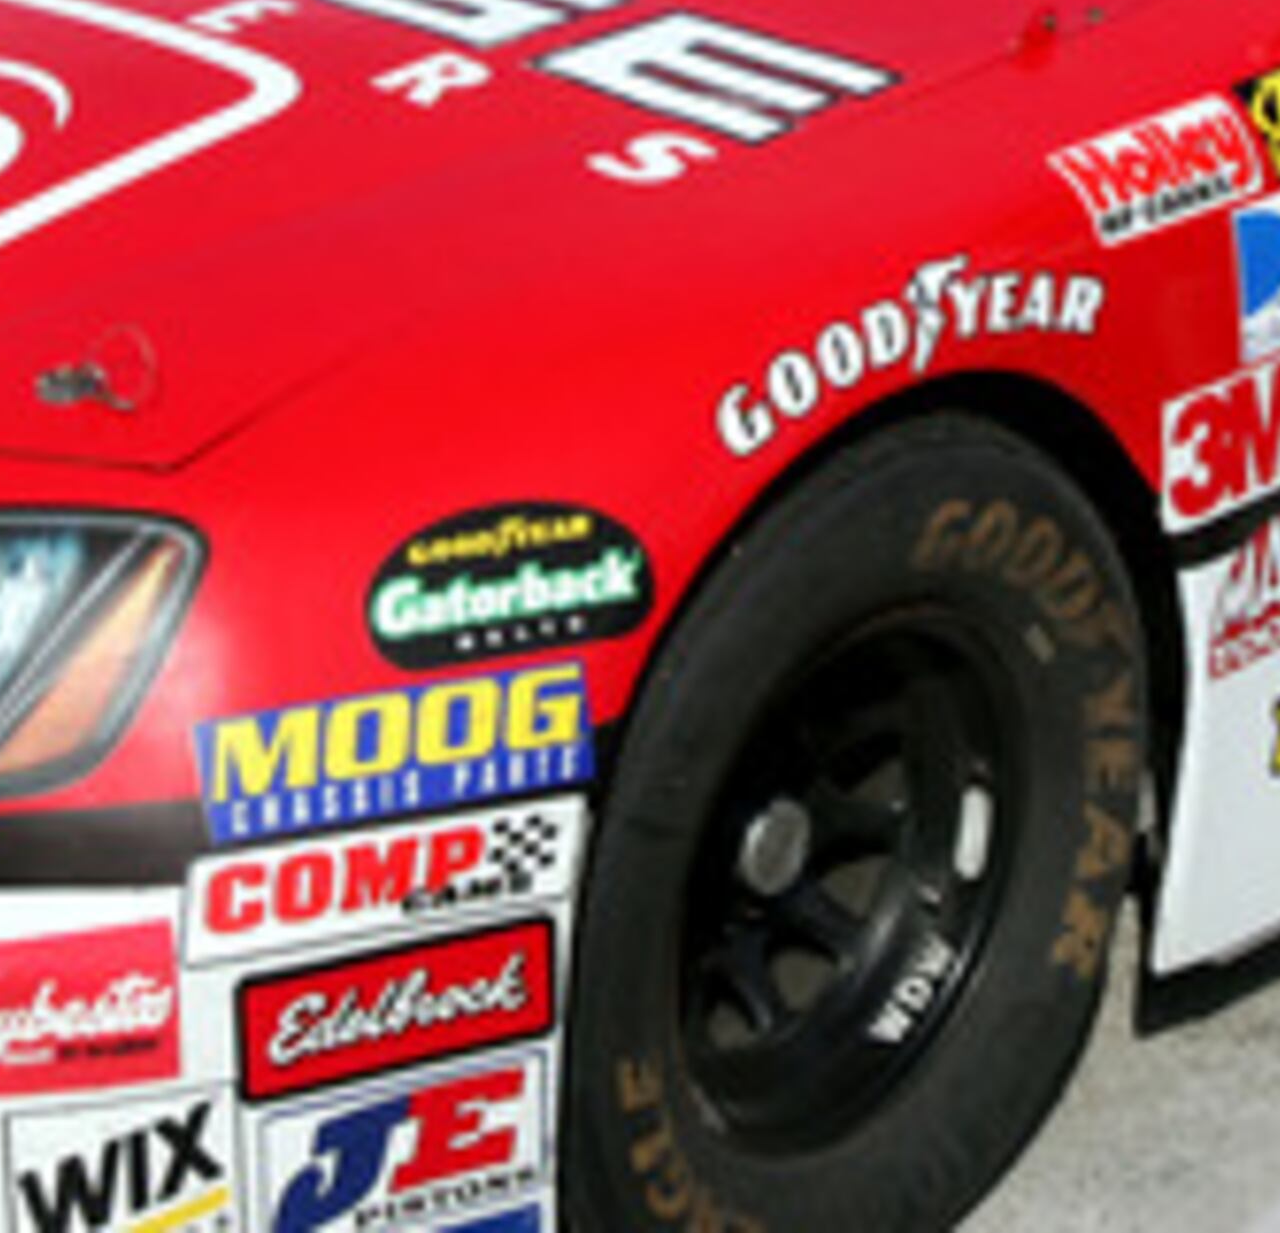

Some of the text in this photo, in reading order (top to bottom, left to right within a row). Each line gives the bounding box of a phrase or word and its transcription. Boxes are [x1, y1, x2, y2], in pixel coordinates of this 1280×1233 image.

[1070, 112, 1248, 212] Holley
[716, 254, 1104, 456] GOODYEAR
[370, 544, 644, 642] Gatorback
[212, 663, 584, 804] MOOG
[202, 824, 488, 936] COMP
[268, 948, 526, 1068] Edelbrock
[18, 1101, 224, 1233] WIX
[270, 1068, 526, 1233] JE
